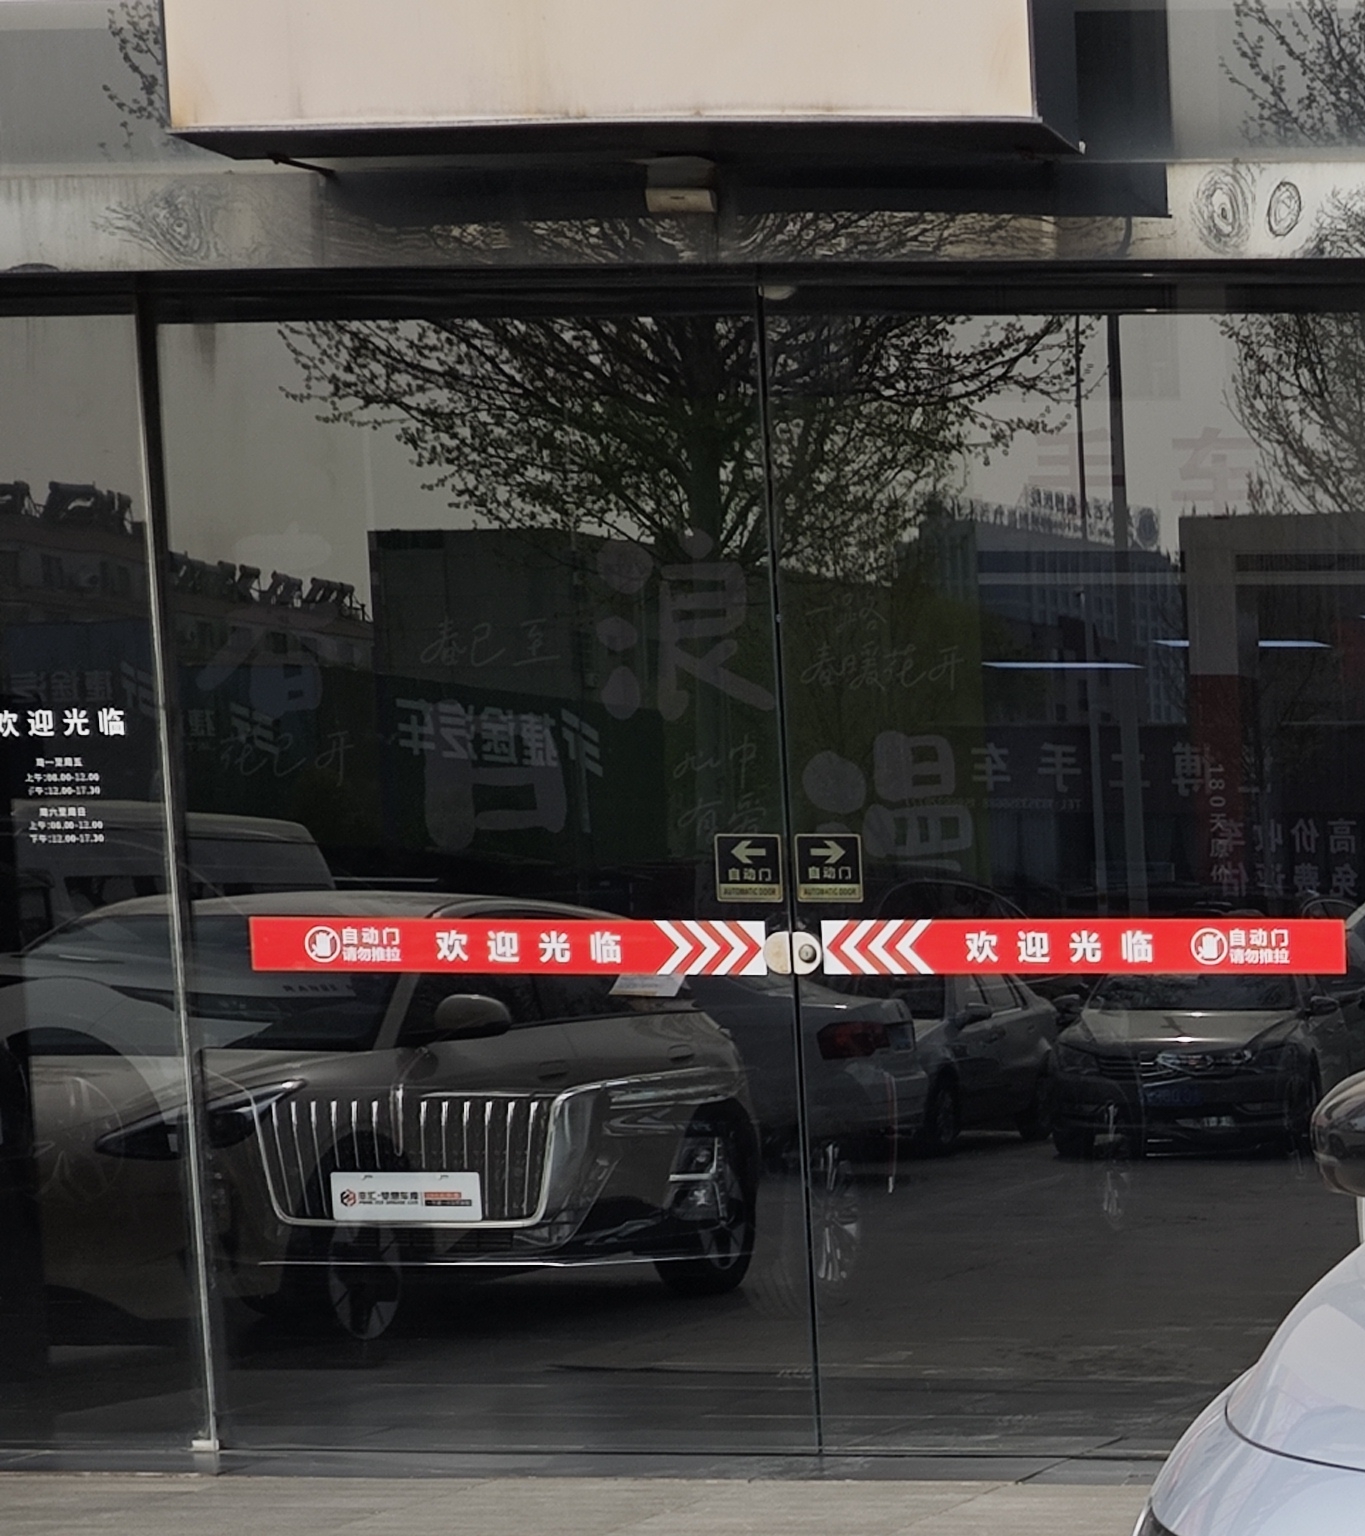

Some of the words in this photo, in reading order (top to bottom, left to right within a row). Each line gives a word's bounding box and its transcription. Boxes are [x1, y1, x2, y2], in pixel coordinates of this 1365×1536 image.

[728, 867, 771, 881] 自动门
[808, 866, 851, 880] 自动门
[723, 887, 757, 896] AUTOMATIC
[759, 887, 777, 896] DOOR
[803, 887, 838, 896] AUTOMATIC
[839, 887, 857, 896] DOOR
[342, 927, 401, 945] 自动门
[1229, 927, 1290, 946] 自动门
[342, 946, 402, 963] 请勿推拉
[436, 929, 622, 963] 欢迎光临
[965, 929, 1154, 963] 欢迎光临
[1229, 947, 1290, 964] 请勿推拉
